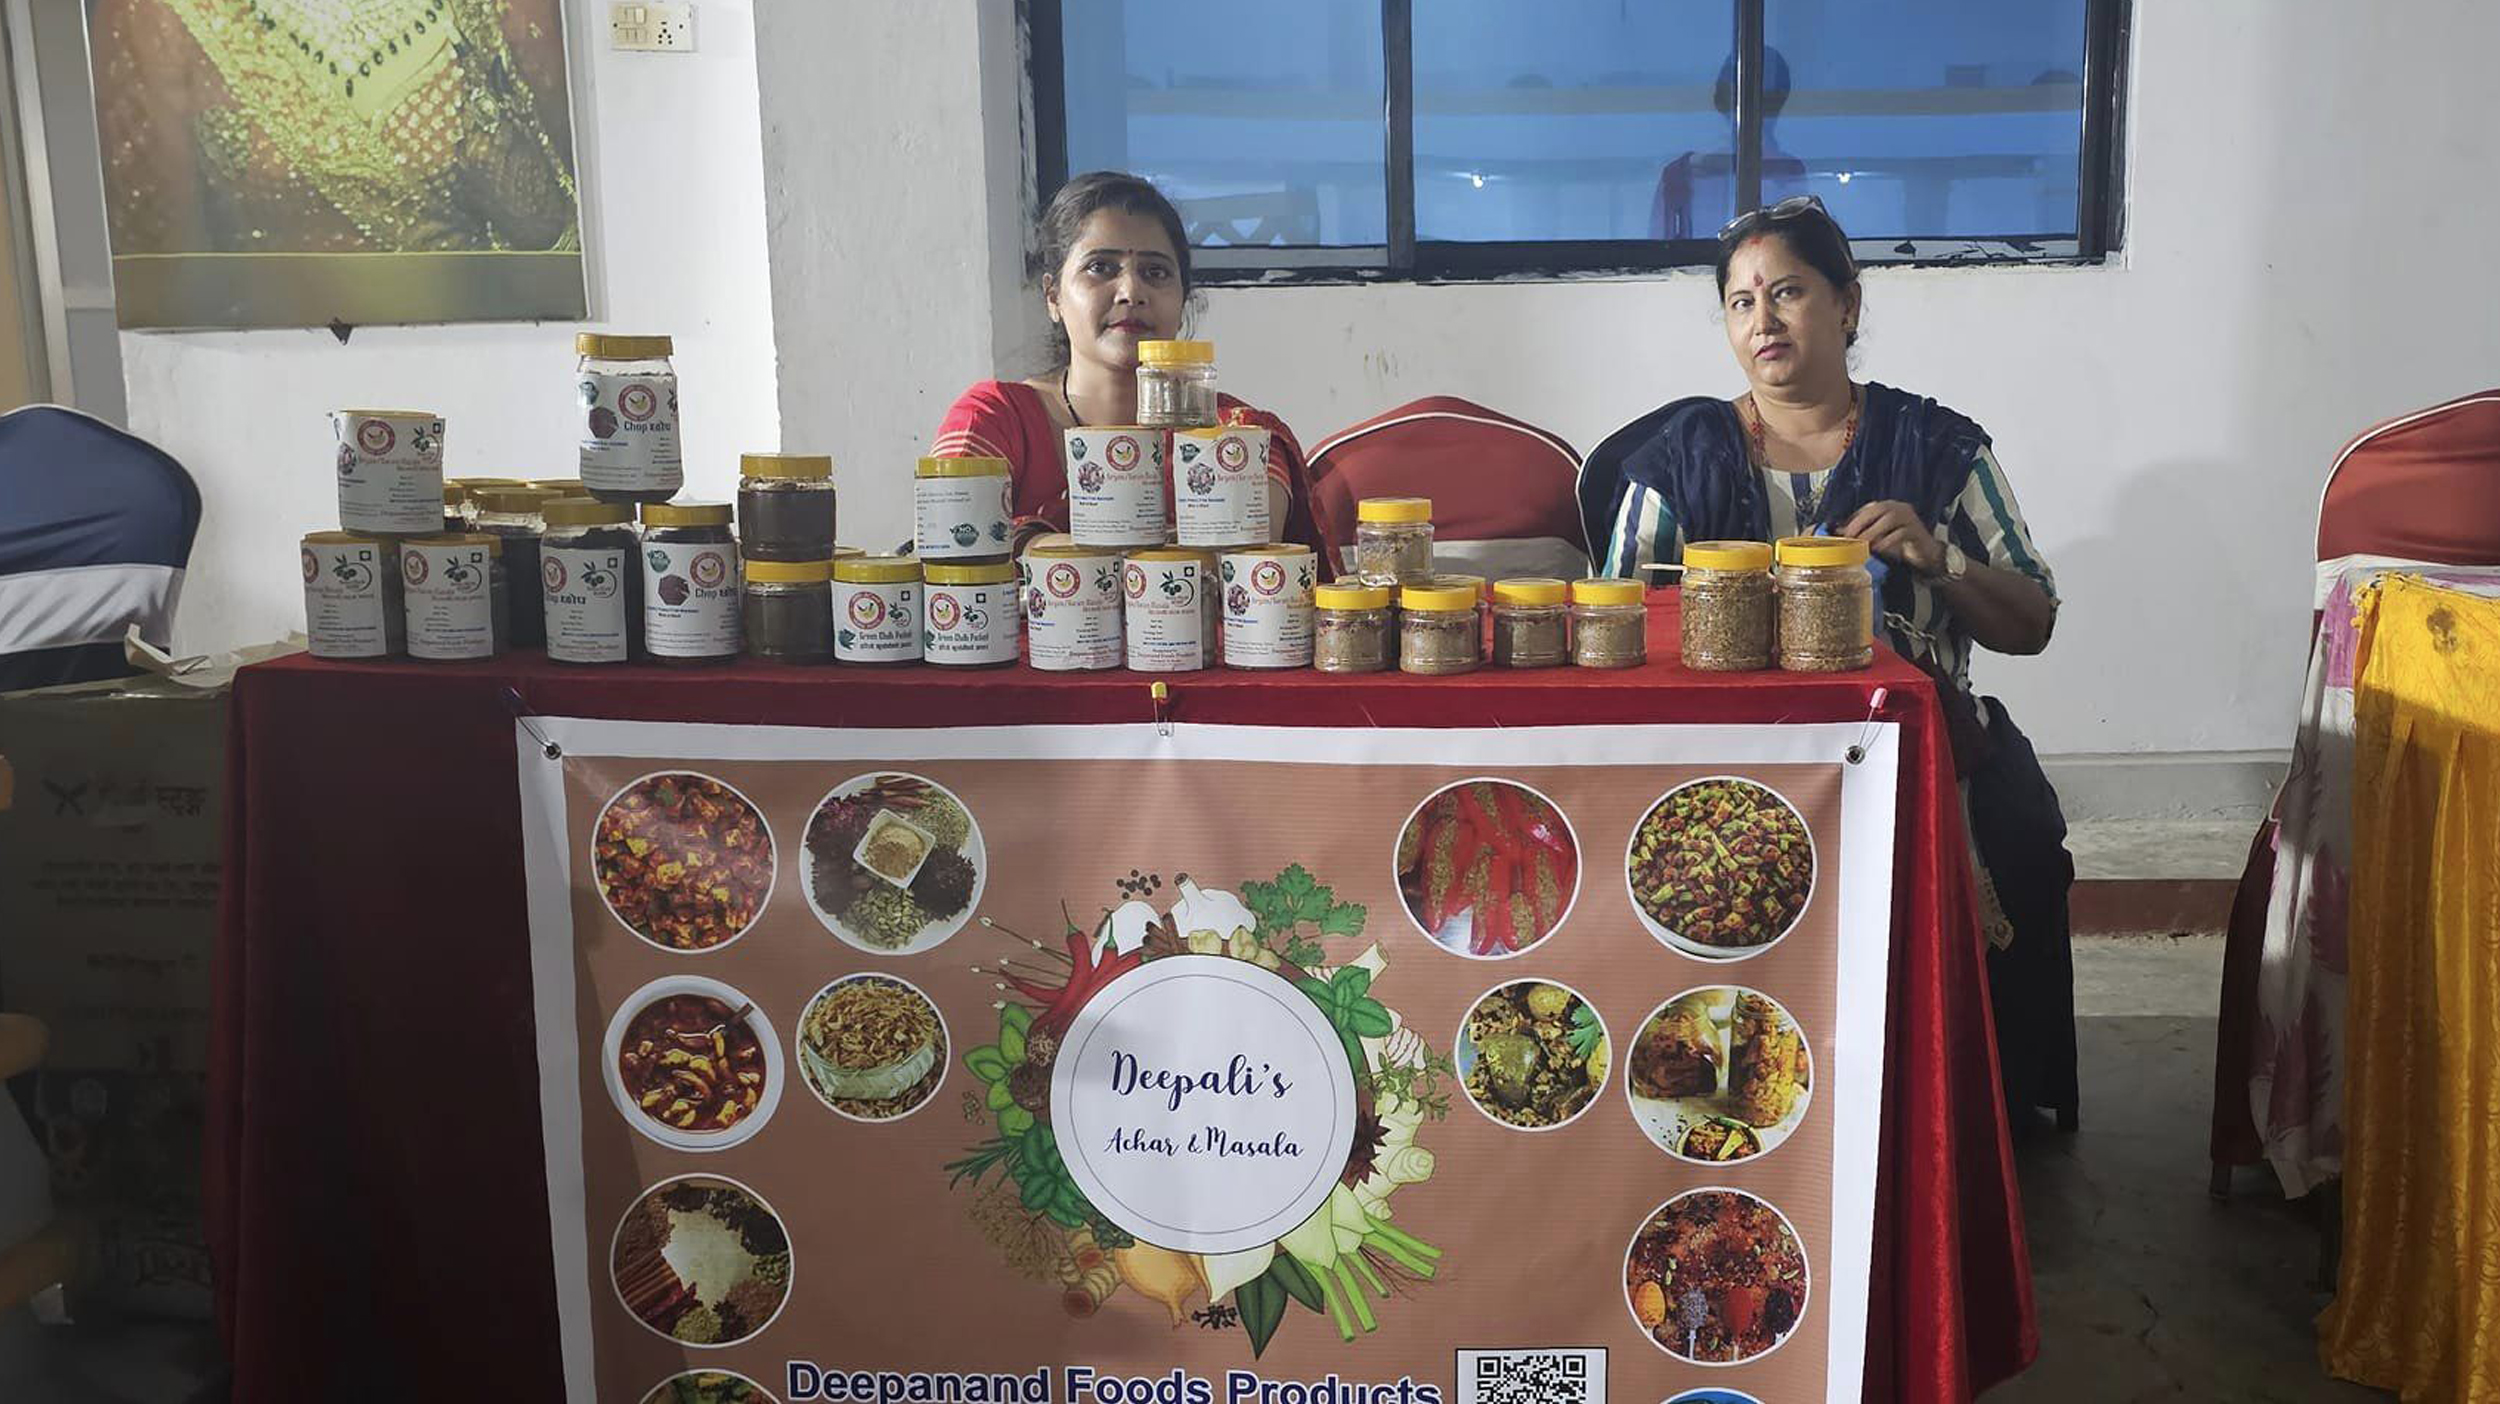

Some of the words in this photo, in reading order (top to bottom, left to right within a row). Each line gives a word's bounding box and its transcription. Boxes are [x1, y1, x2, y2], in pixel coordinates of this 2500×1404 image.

[1111, 1050, 1293, 1111] Deepali's
[1104, 1126, 1179, 1156] Achar
[1188, 1133, 1203, 1153] &
[1206, 1126, 1303, 1157] Masala
[787, 1361, 1050, 1404] Deepanand
[1065, 1366, 1212, 1404] Foods
[1227, 1369, 1441, 1404] Products
